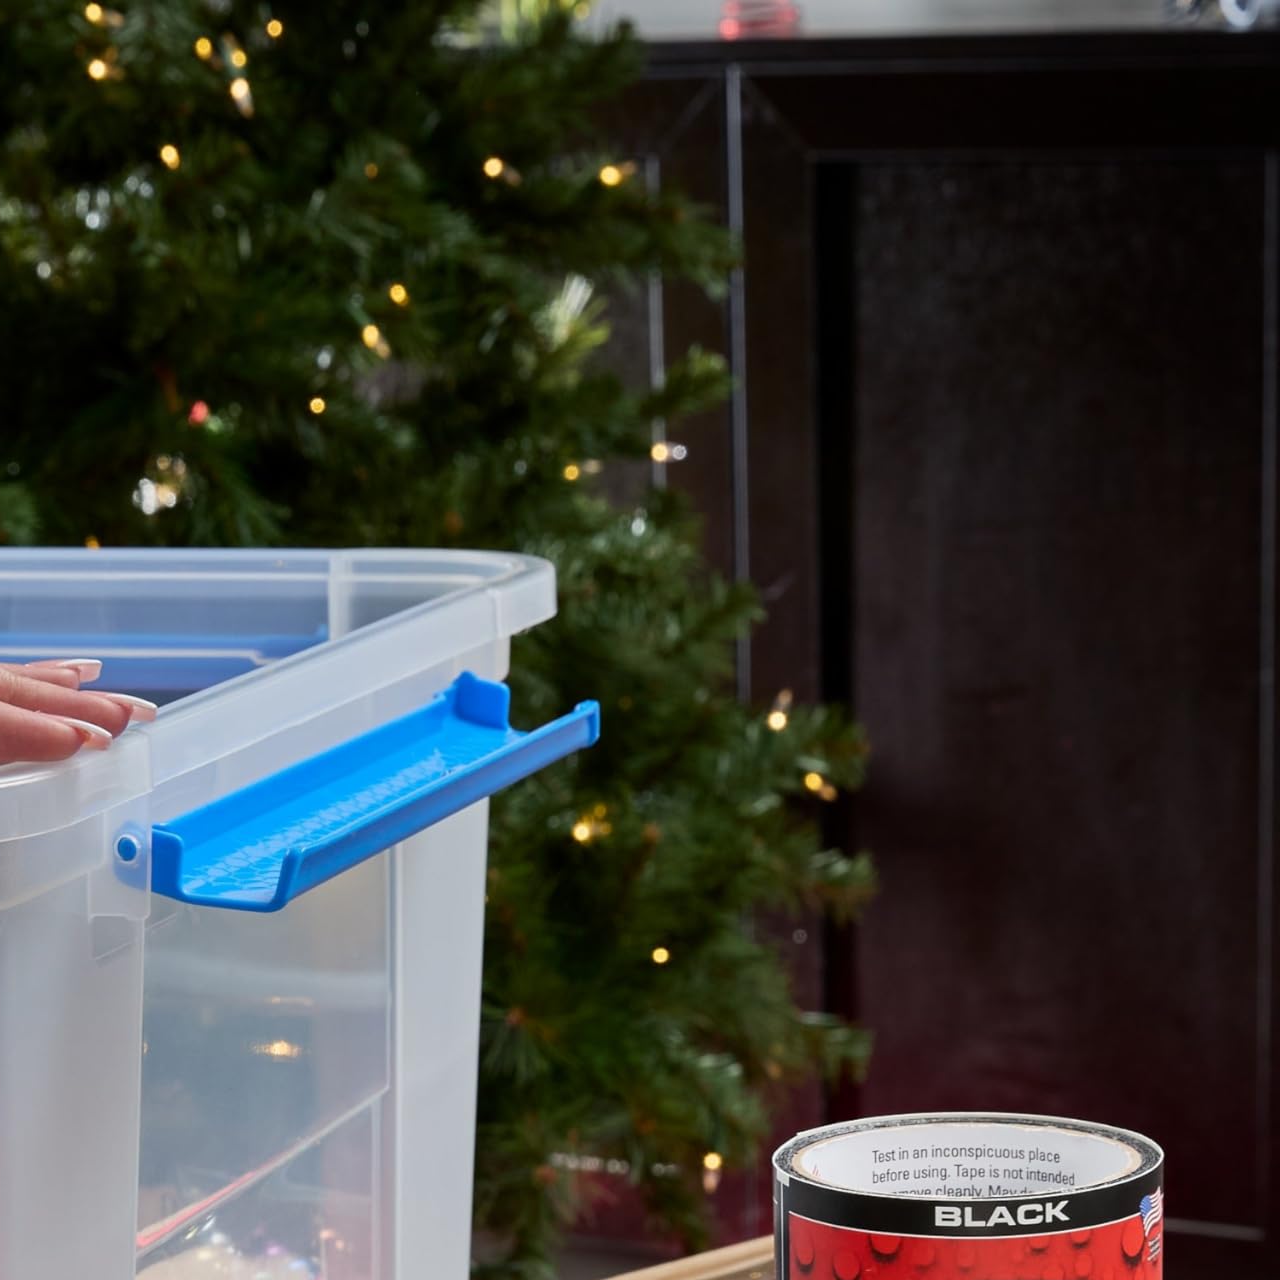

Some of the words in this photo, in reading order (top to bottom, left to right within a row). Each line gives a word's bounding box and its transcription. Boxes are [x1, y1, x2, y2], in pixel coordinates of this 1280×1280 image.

[872, 1150, 896, 1164] Test
[898, 1147, 909, 1160] in
[912, 1148, 928, 1159] an
[931, 1144, 1025, 1160] inconspicuous
[1028, 1147, 1061, 1163] place
[872, 1168, 910, 1184] before
[913, 1165, 951, 1180] using.
[954, 1164, 986, 1180] Tape
[989, 1165, 1000, 1178] is
[1003, 1167, 1024, 1180] not
[1026, 1167, 1075, 1186] intended
[988, 1185, 1019, 1197] May
[935, 1200, 1070, 1227] BLACK
